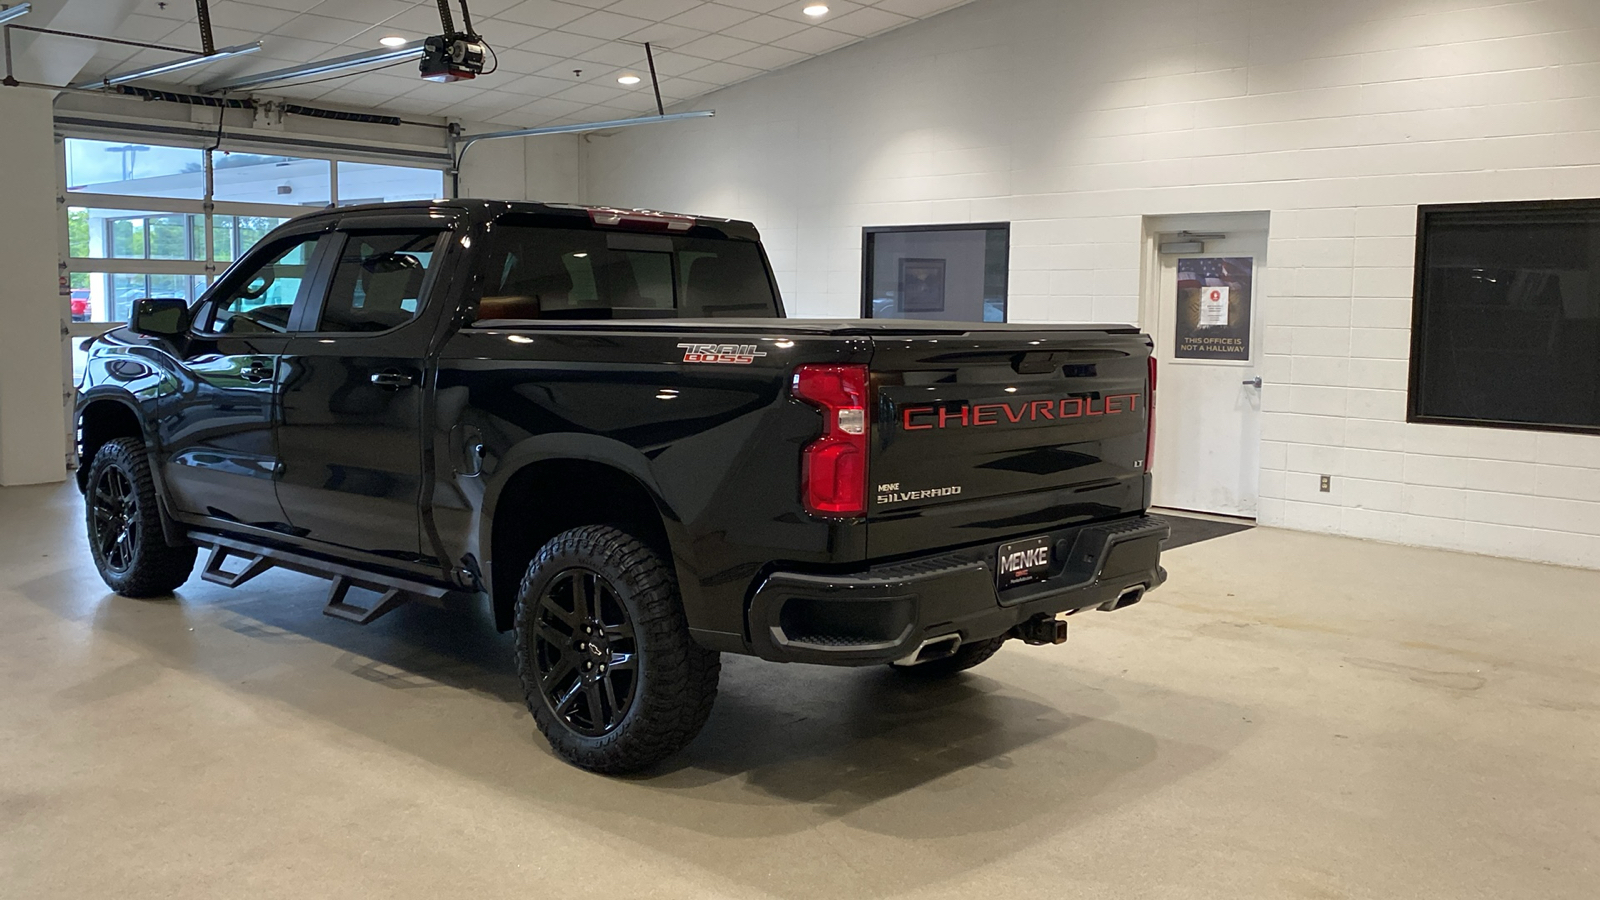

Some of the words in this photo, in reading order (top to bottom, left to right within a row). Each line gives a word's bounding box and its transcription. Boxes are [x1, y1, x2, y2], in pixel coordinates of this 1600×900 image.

[677, 343, 768, 357] TRAIL
[683, 353, 754, 364] BOSS
[902, 393, 1142, 431] CHEVROLET
[1133, 459, 1144, 468] LT
[878, 482, 900, 492] MENKE
[877, 486, 961, 504] SILVERADO
[1001, 546, 1049, 575] MENKE
